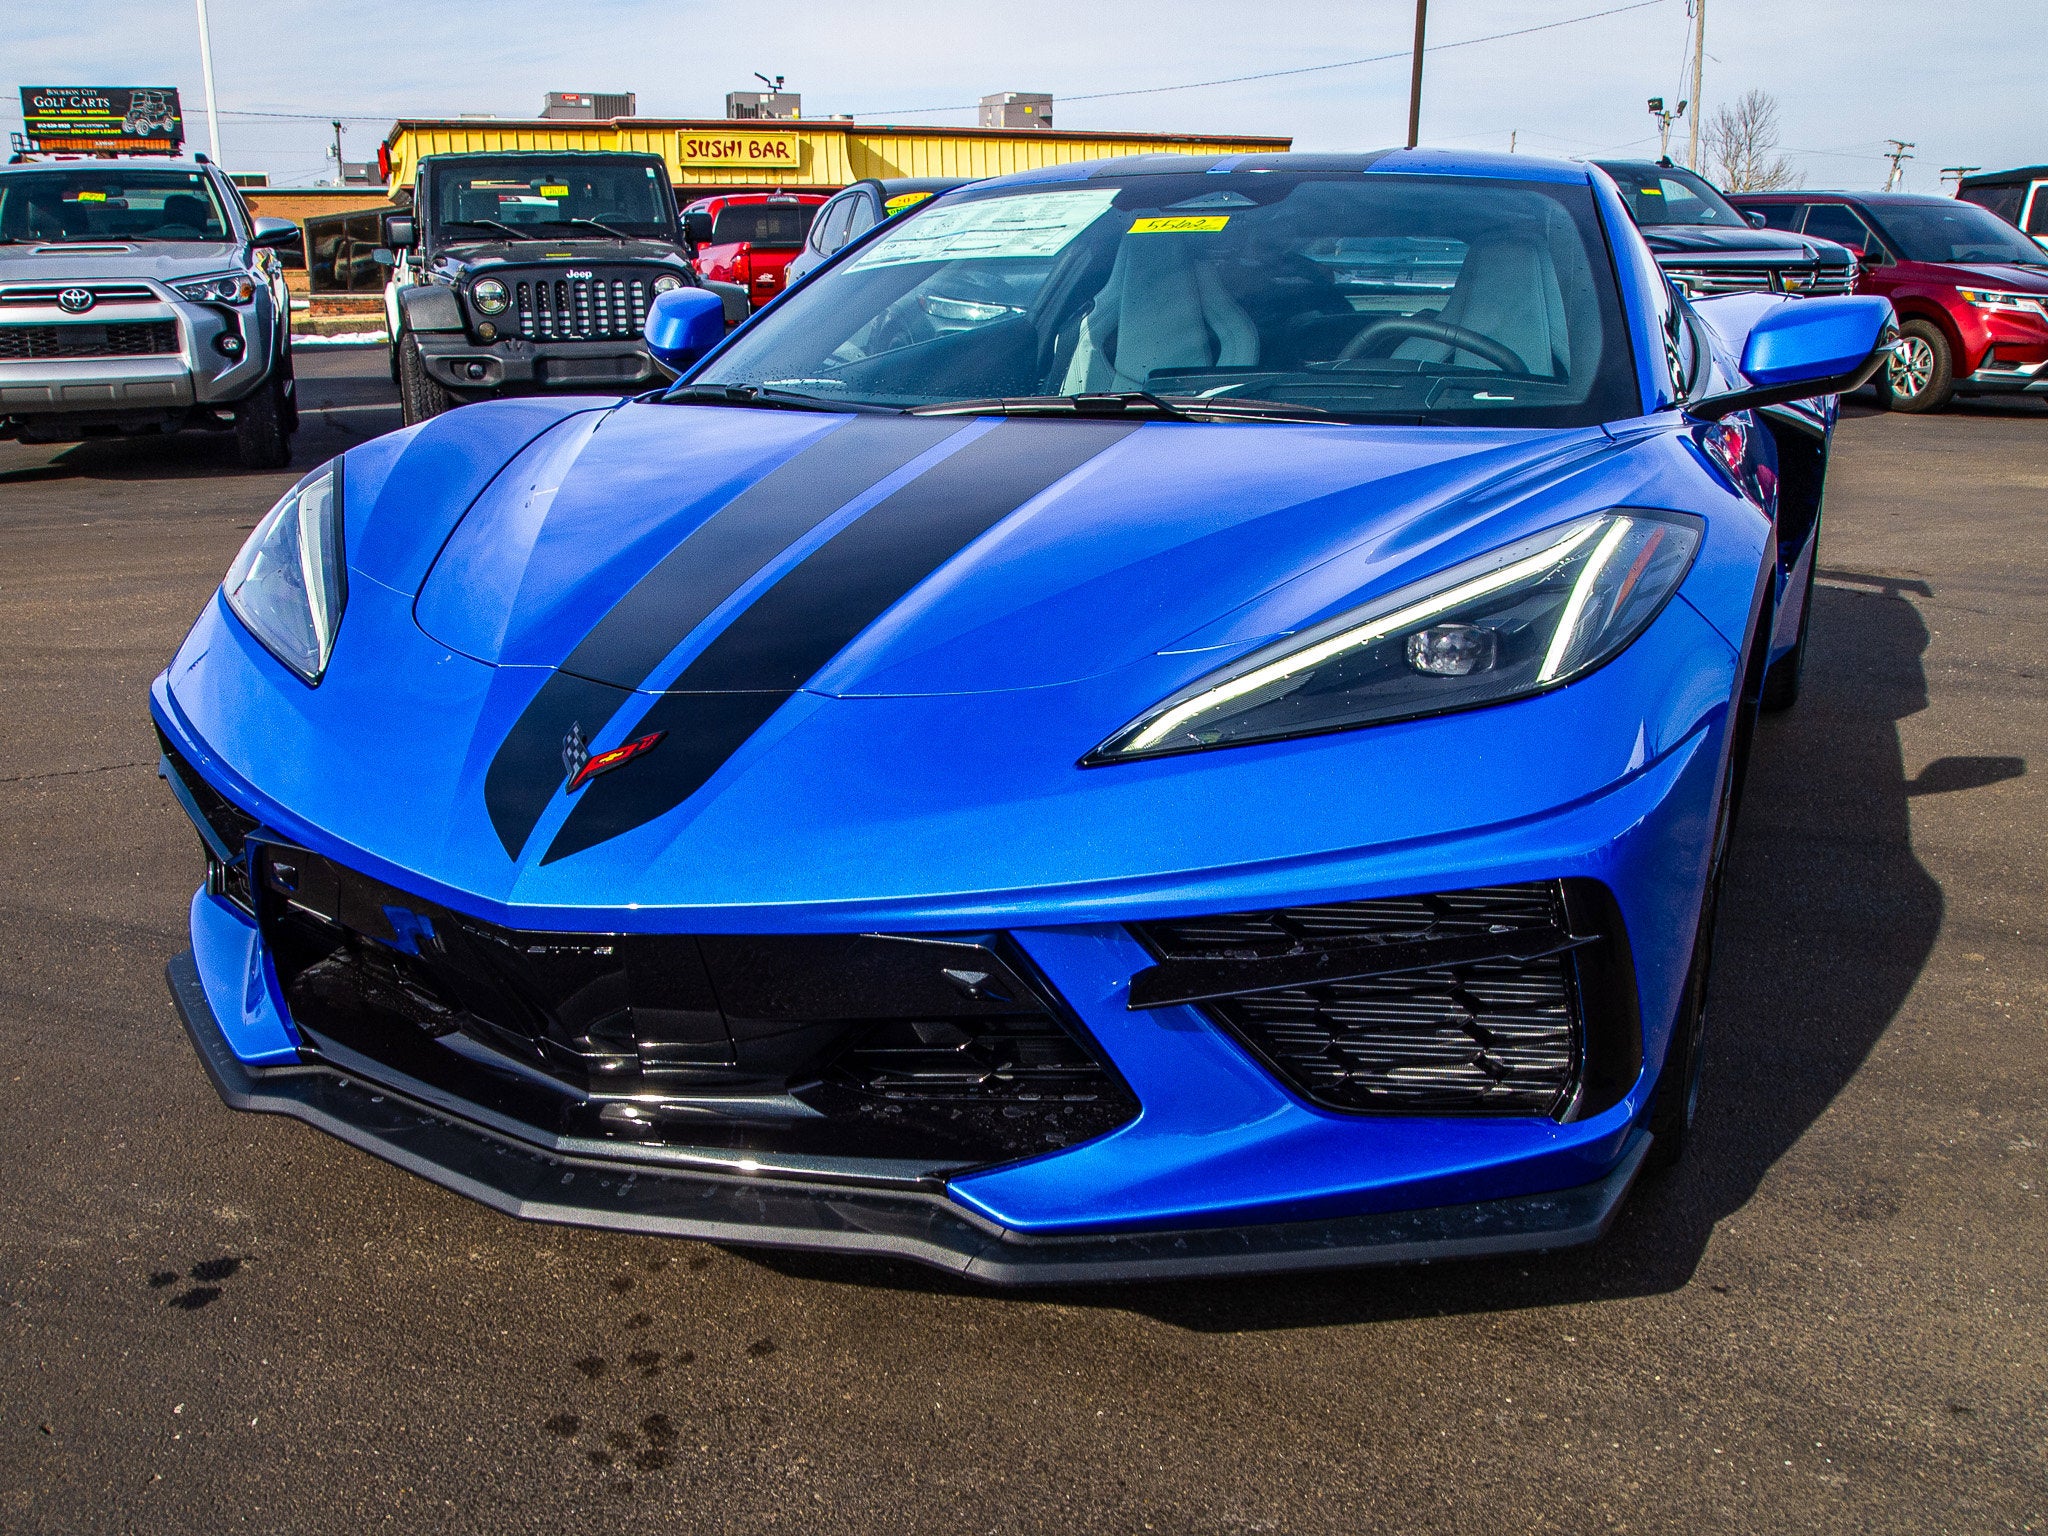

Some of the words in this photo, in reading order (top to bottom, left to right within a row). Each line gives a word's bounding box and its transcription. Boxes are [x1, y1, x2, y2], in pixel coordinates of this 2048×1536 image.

[81, 88, 98, 96] CITY
[33, 96, 66, 108] GOLF
[70, 96, 110, 108] CARTS
[686, 139, 742, 158] SUSHI
[748, 140, 790, 159] BAR
[566, 269, 592, 279] Jeep
